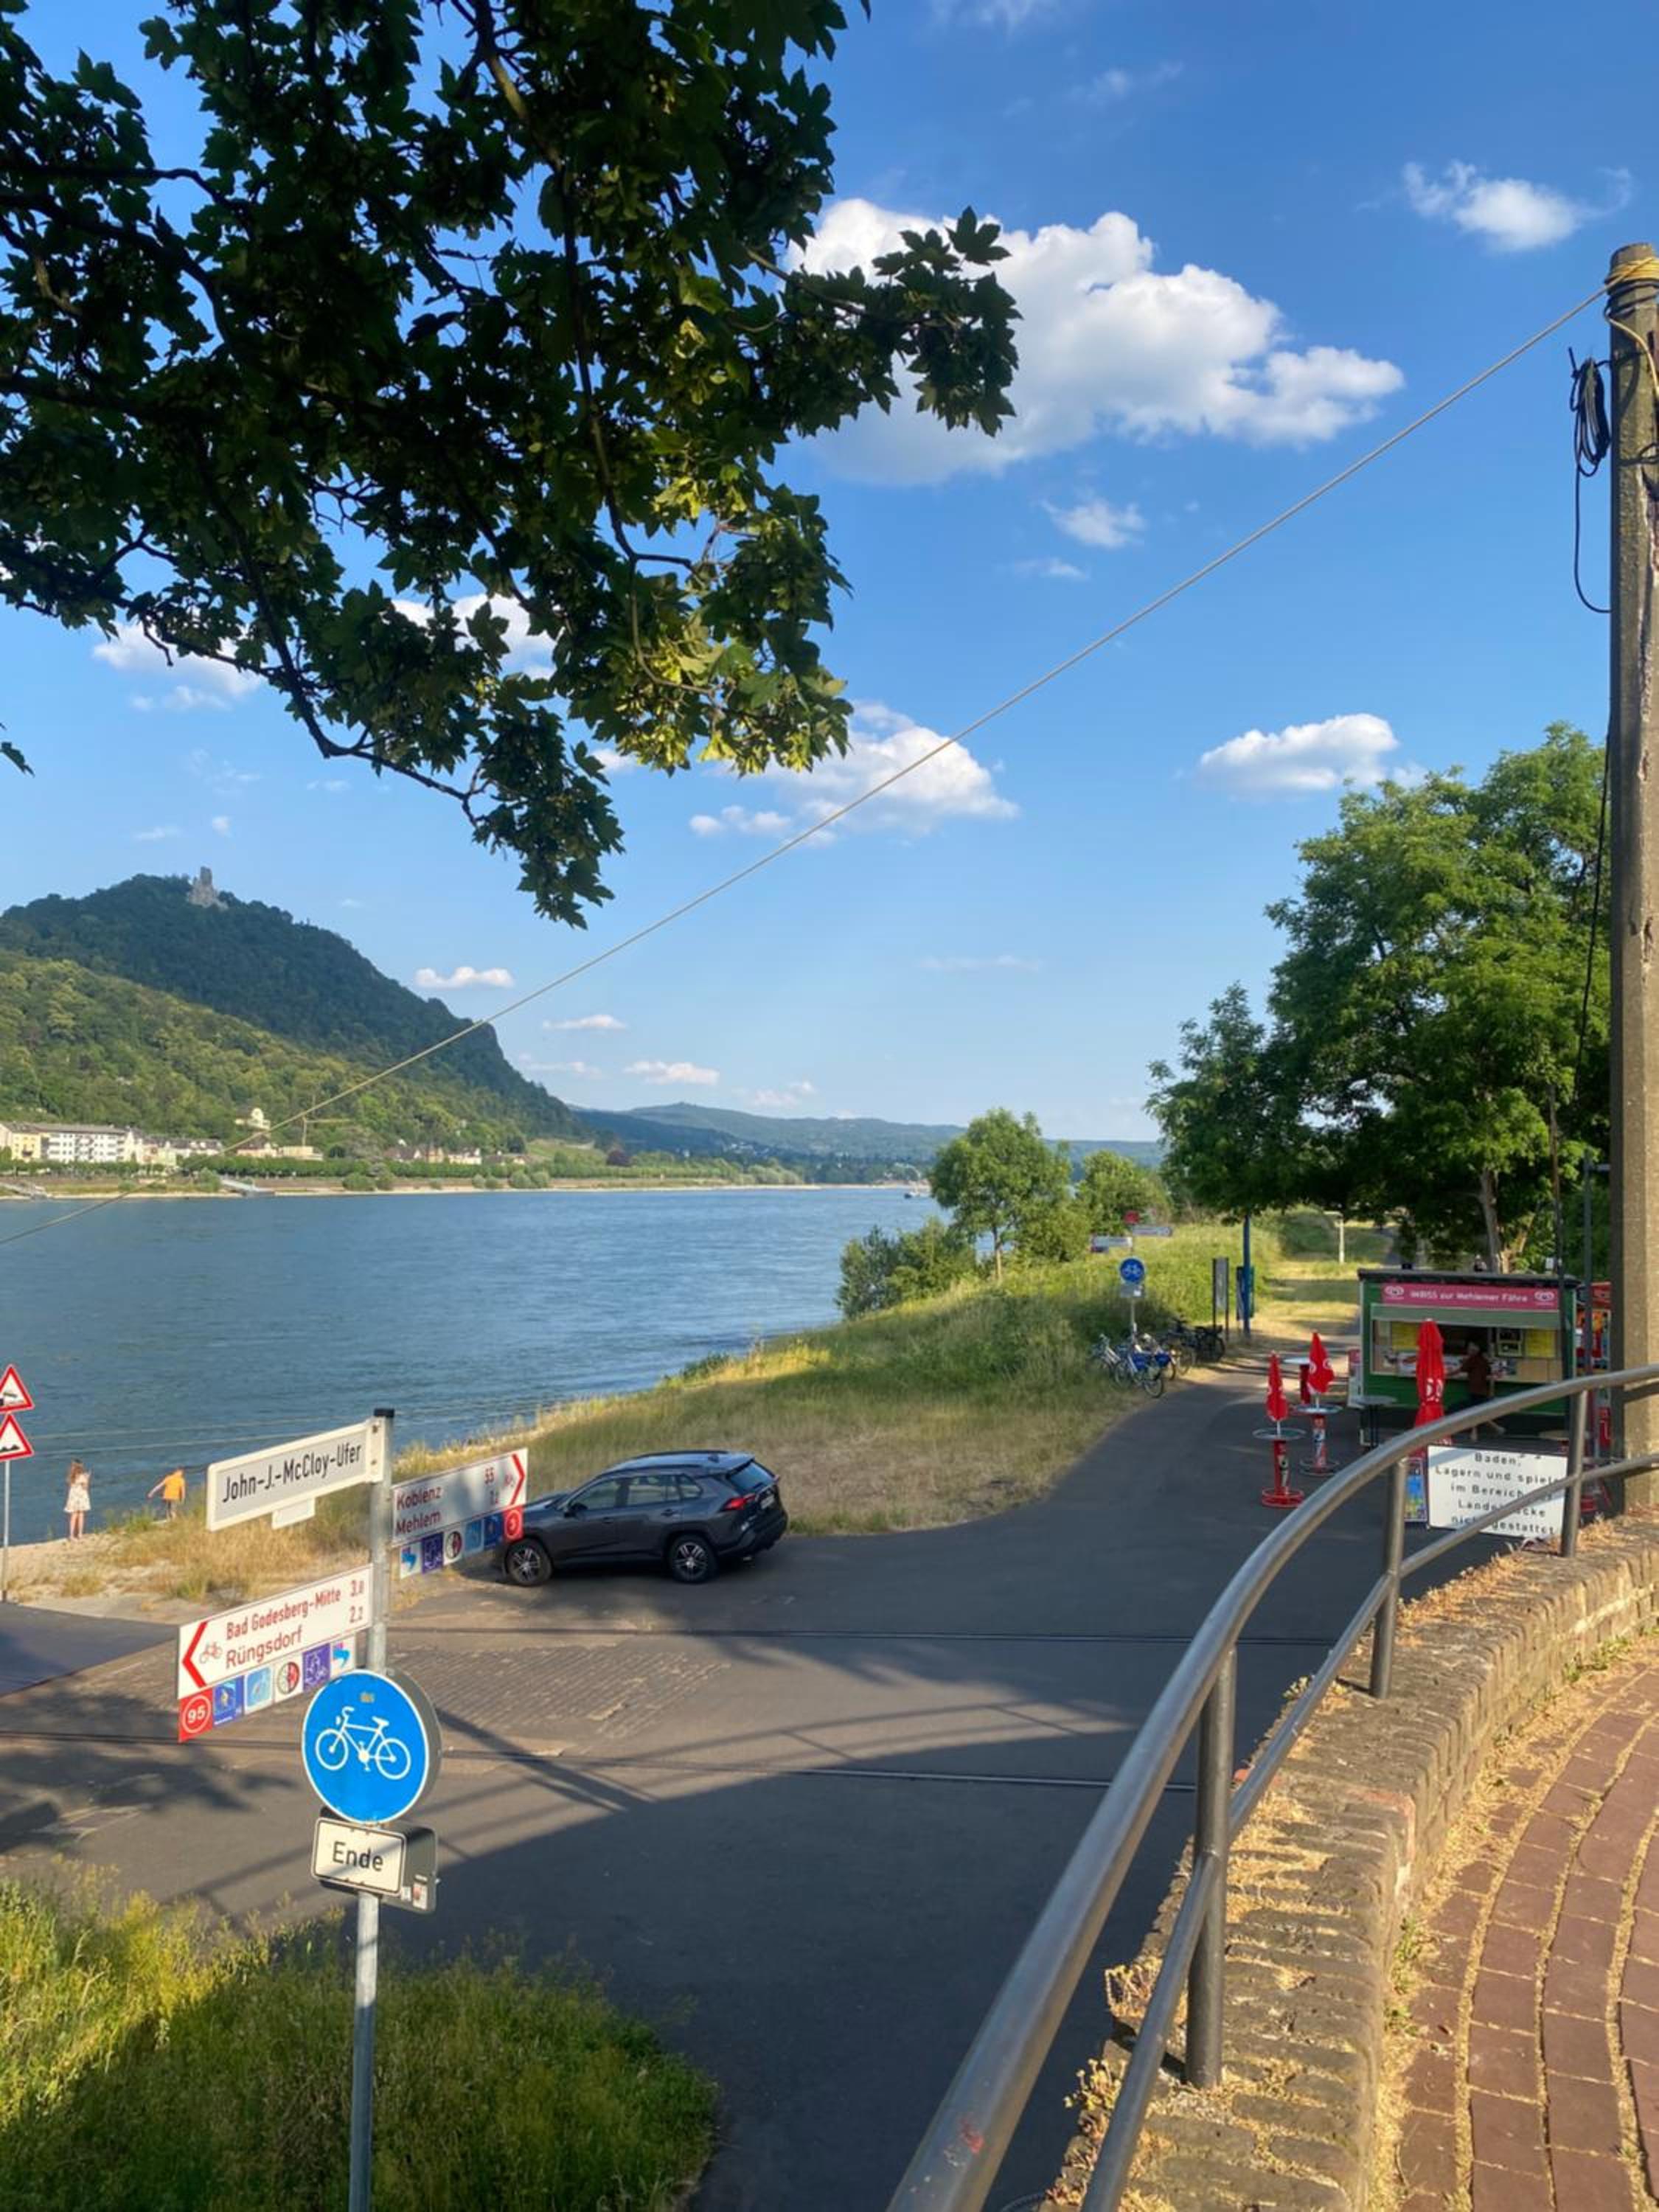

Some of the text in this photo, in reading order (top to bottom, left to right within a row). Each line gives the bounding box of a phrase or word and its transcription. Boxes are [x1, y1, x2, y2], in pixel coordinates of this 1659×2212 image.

[223, 1443, 361, 1503] John-J.-McCloy-Ufer
[1436, 1466, 1481, 1479] Lagern
[1486, 1472, 1512, 1481] und
[397, 1486, 442, 1510] Koblenz
[1450, 1482, 1466, 1492] im
[1472, 1484, 1524, 1498] Bereich
[395, 1512, 441, 1534] Mehlem
[226, 1616, 248, 1640] Bad
[251, 1588, 341, 1625] Godesberg-Mitte
[226, 1624, 303, 1670] Rüngsdorf
[187, 1705, 206, 1724] 95
[333, 1840, 383, 1871] Ende
